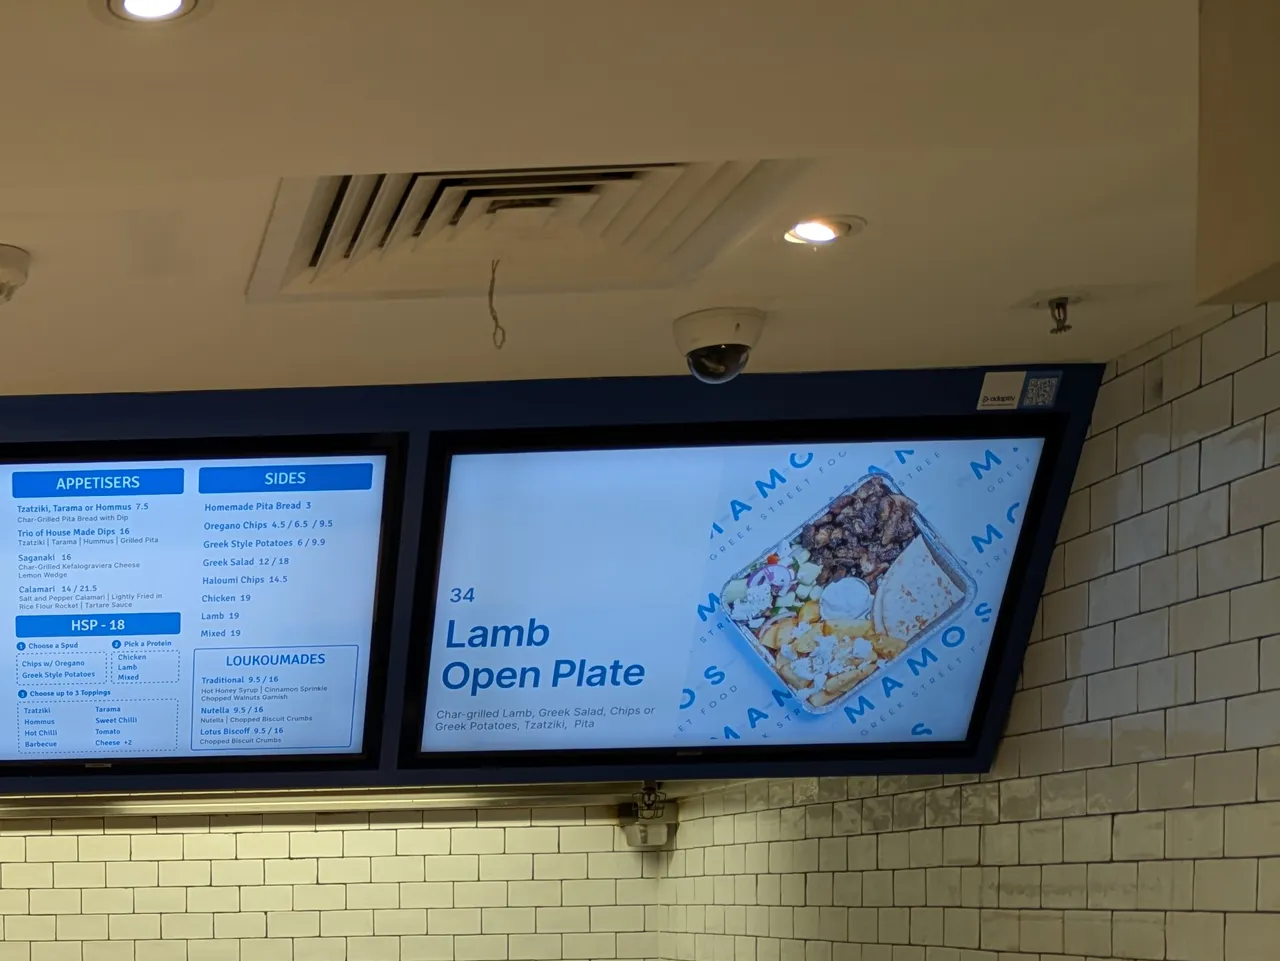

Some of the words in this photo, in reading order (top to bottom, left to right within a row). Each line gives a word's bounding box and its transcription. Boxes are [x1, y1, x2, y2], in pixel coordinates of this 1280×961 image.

[56, 476, 140, 490] APPETISERS
[265, 472, 306, 485] SIDES
[17, 505, 51, 513] Tzatziki,
[53, 504, 83, 512] Tarama
[205, 502, 254, 512] Homemade
[256, 502, 274, 510] Pita
[276, 501, 301, 510] Bread
[117, 514, 129, 522] Dip
[710, 525, 753, 561] GREEK
[761, 478, 810, 520] STREET
[204, 522, 241, 532] Oregano
[243, 521, 267, 531] Chips
[294, 520, 308, 528] 6.5
[319, 520, 333, 528] 9.5
[35, 529, 44, 537] of
[46, 529, 71, 537] House
[73, 528, 95, 536] Made
[97, 528, 116, 537] Dips
[203, 540, 229, 549] Greek
[231, 540, 253, 550] Style
[255, 539, 293, 547] Potatoes
[312, 538, 325, 546] 9.9
[18, 553, 55, 564] Saganaki
[203, 558, 228, 567] Greek
[230, 557, 254, 566] Salad
[279, 557, 289, 565] 18
[203, 576, 238, 585] Haloumi
[241, 576, 265, 585] Chips
[19, 585, 56, 593] Calamari
[202, 594, 236, 603] Chicken
[241, 594, 251, 602] 19
[450, 588, 475, 603] 34
[201, 612, 225, 620] Lamb
[229, 612, 240, 620] 19
[72, 619, 98, 631] HSP
[110, 619, 125, 630] 18
[201, 629, 226, 637] Mixed
[231, 629, 241, 637] 19
[446, 618, 550, 648] Lamb
[61, 642, 79, 650] Spud
[226, 653, 325, 666] LOUKOUMADES
[202, 676, 244, 684] Traditional
[442, 662, 540, 696] Open
[552, 660, 645, 687] Plate
[81, 689, 111, 697] Toppings
[436, 709, 500, 721] Char-grilled
[503, 708, 535, 719] Lamb,
[538, 708, 571, 717] Greek
[574, 707, 606, 718] Salad,
[610, 707, 641, 717] Chips
[435, 722, 467, 731] Greek
[470, 721, 520, 731] Potatoes,
[525, 719, 567, 730] Tzatziki,
[574, 720, 595, 728] Pita
[223, 727, 250, 735] Biscoff
